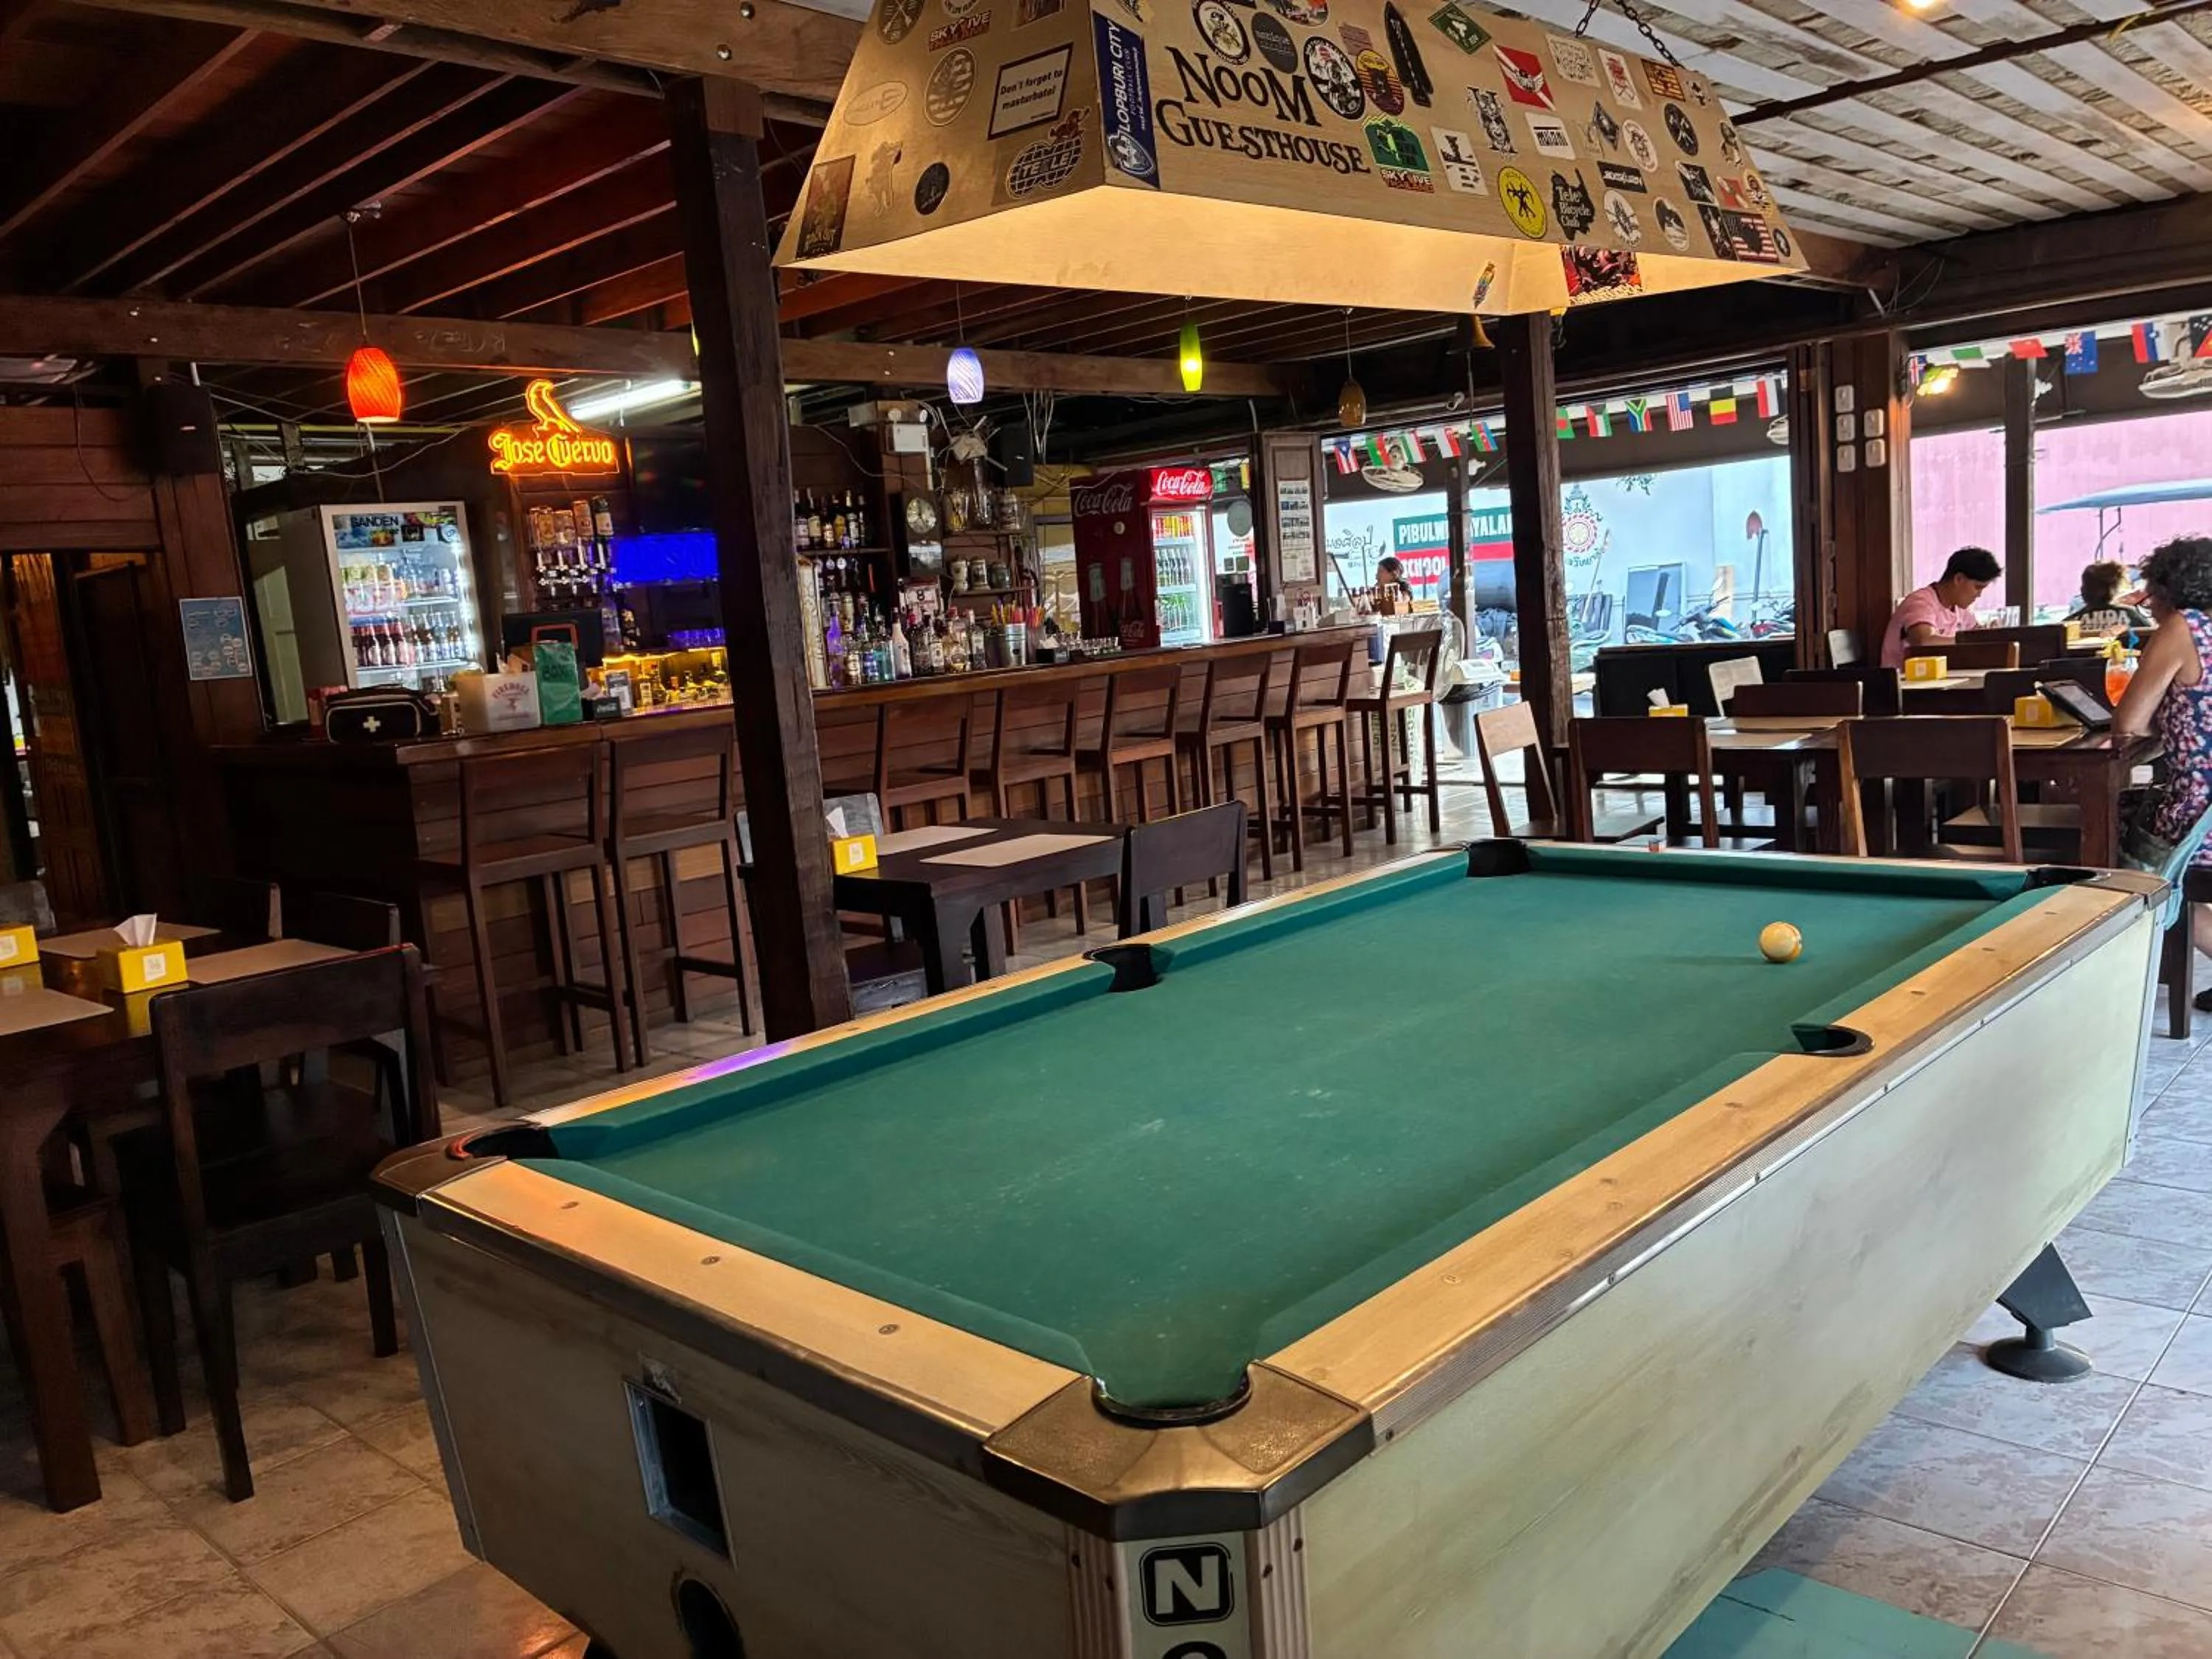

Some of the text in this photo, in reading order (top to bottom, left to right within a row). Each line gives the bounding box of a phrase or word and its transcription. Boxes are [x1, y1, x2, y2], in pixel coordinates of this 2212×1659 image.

[1107, 20, 1130, 132] LOPBURI CITY
[1166, 46, 1322, 127] NOOM
[1156, 99, 1371, 175] GUESTHOUSE
[350, 516, 399, 527] SANDEN
